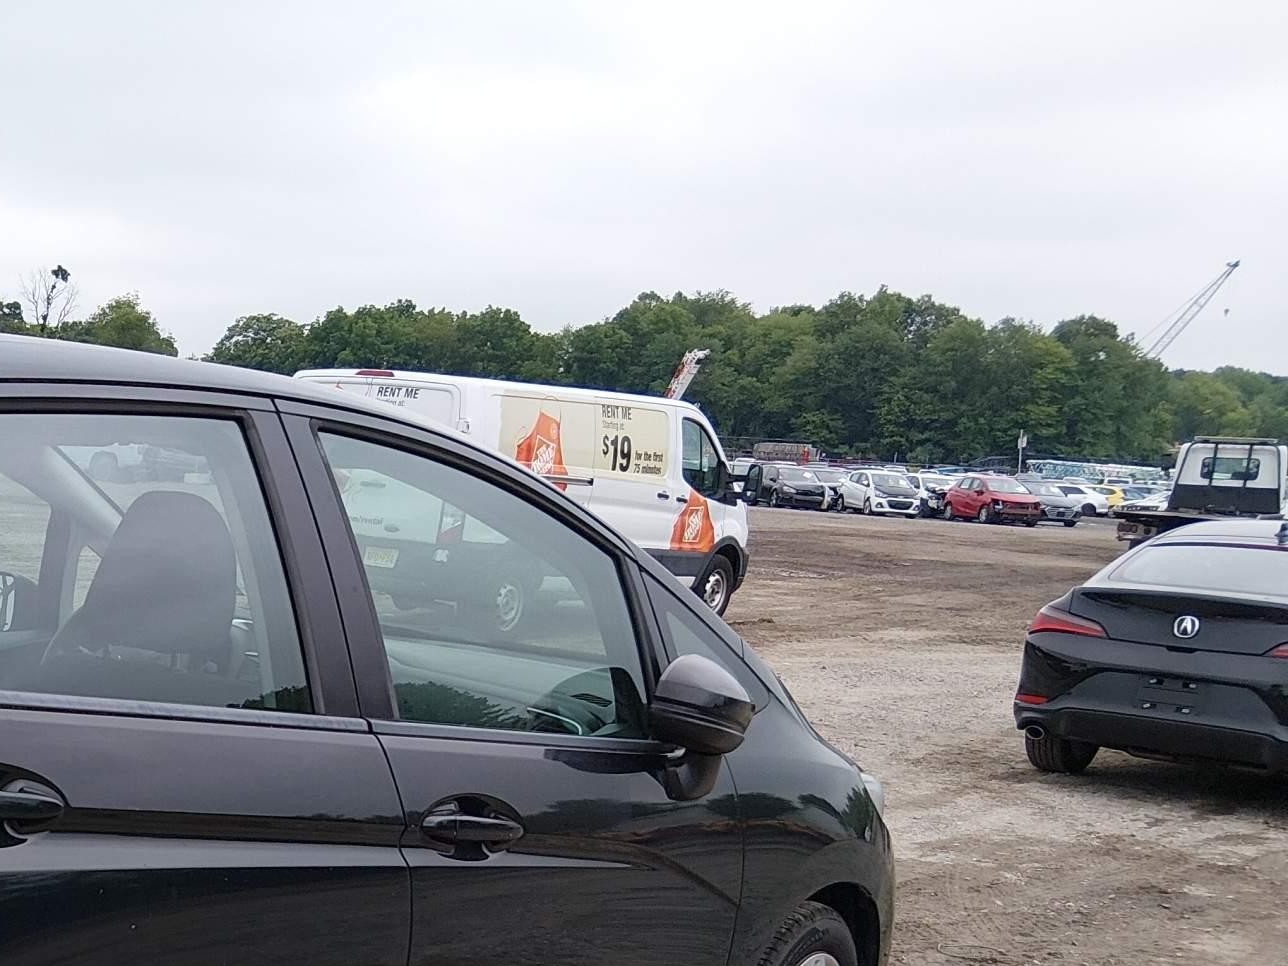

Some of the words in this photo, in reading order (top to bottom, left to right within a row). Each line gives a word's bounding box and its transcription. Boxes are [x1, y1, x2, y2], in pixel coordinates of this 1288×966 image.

[377, 386, 402, 398] RENT
[404, 388, 420, 400] ME
[602, 404, 619, 419] RENT
[621, 407, 632, 420] ME
[602, 434, 632, 472] $19
[633, 464, 640, 473] 75
